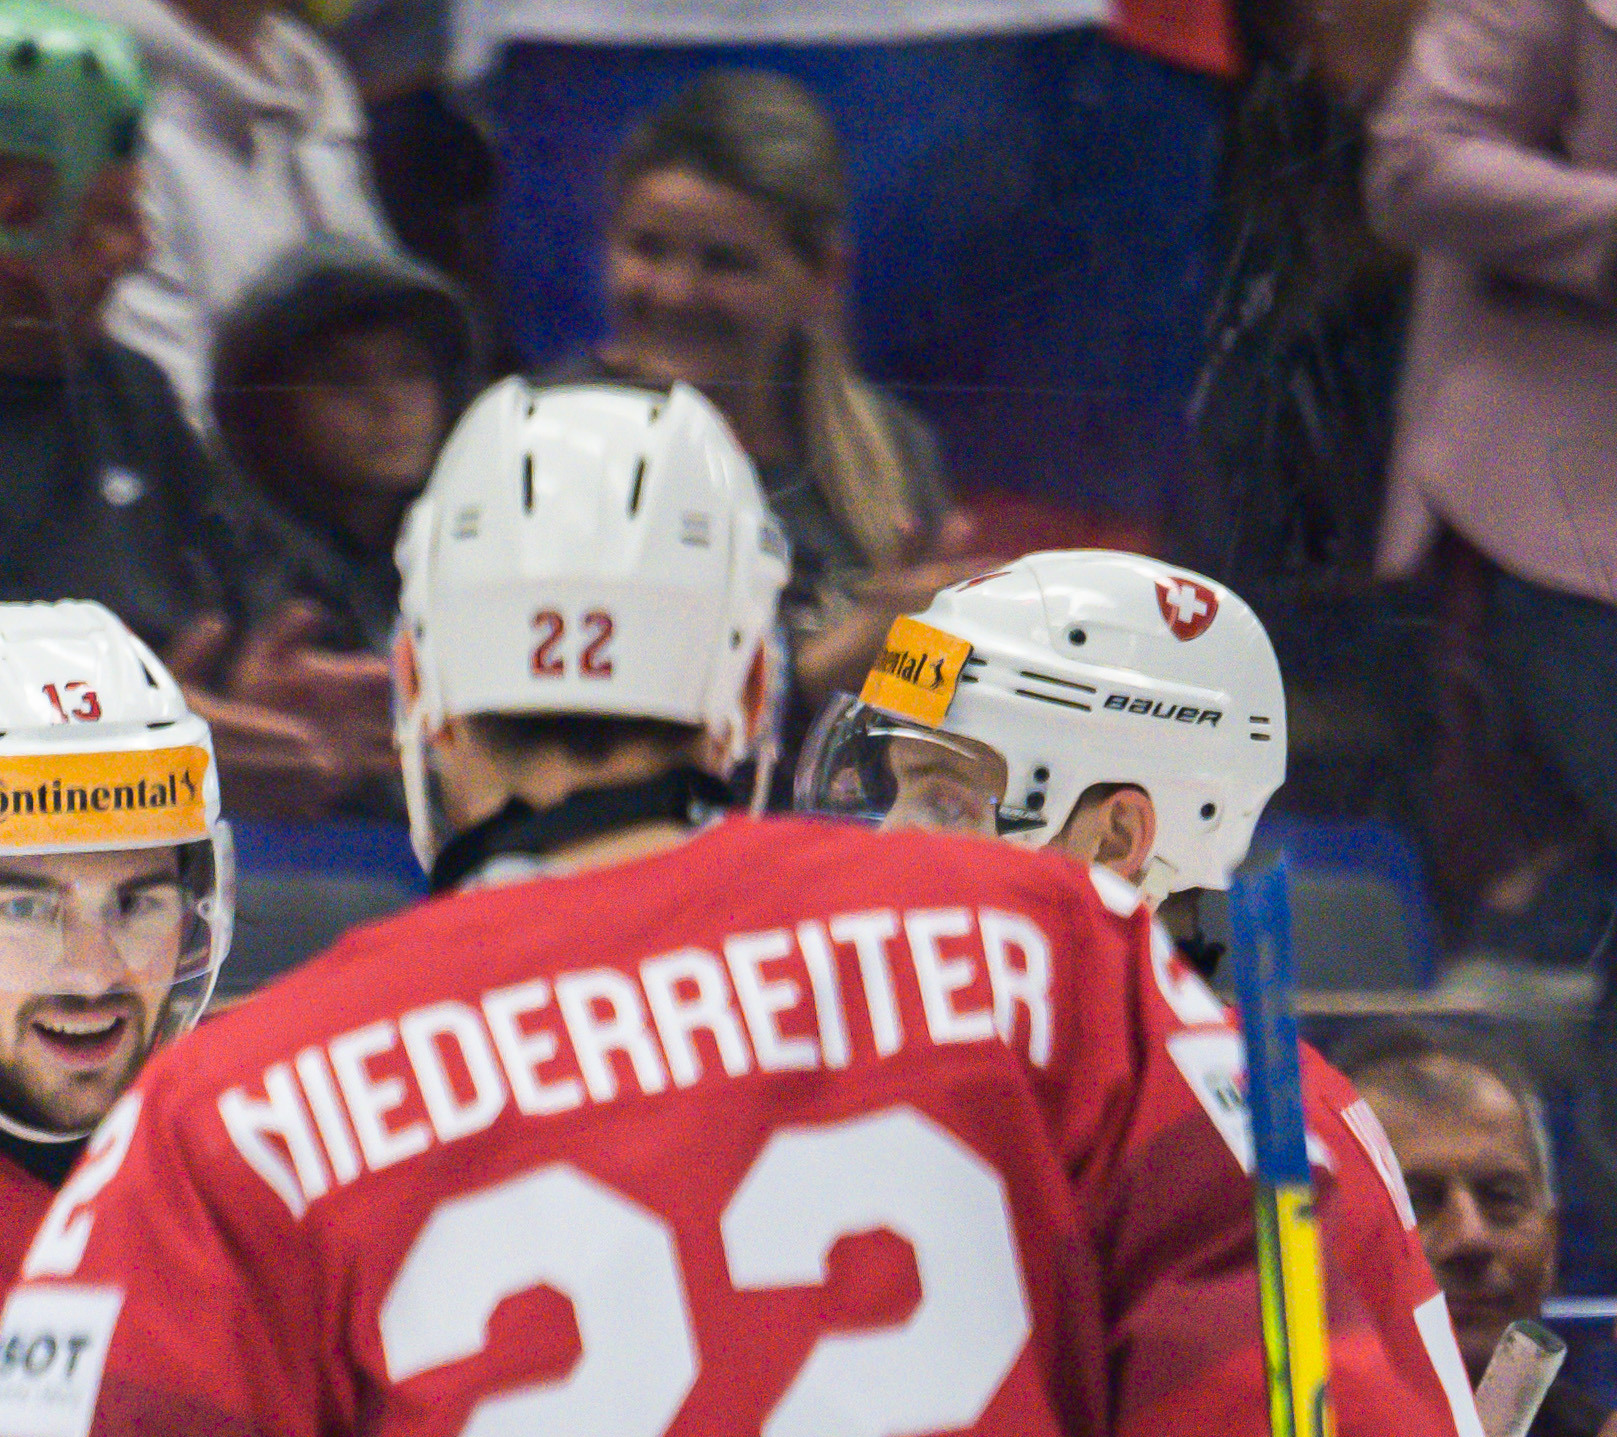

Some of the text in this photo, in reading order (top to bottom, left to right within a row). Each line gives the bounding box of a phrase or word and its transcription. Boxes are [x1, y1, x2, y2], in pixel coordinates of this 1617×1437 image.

[529, 608, 616, 679] 22
[42, 681, 102, 723] 13
[1103, 694, 1223, 729] BAUER
[216, 906, 1053, 1221] NIEDERREITER
